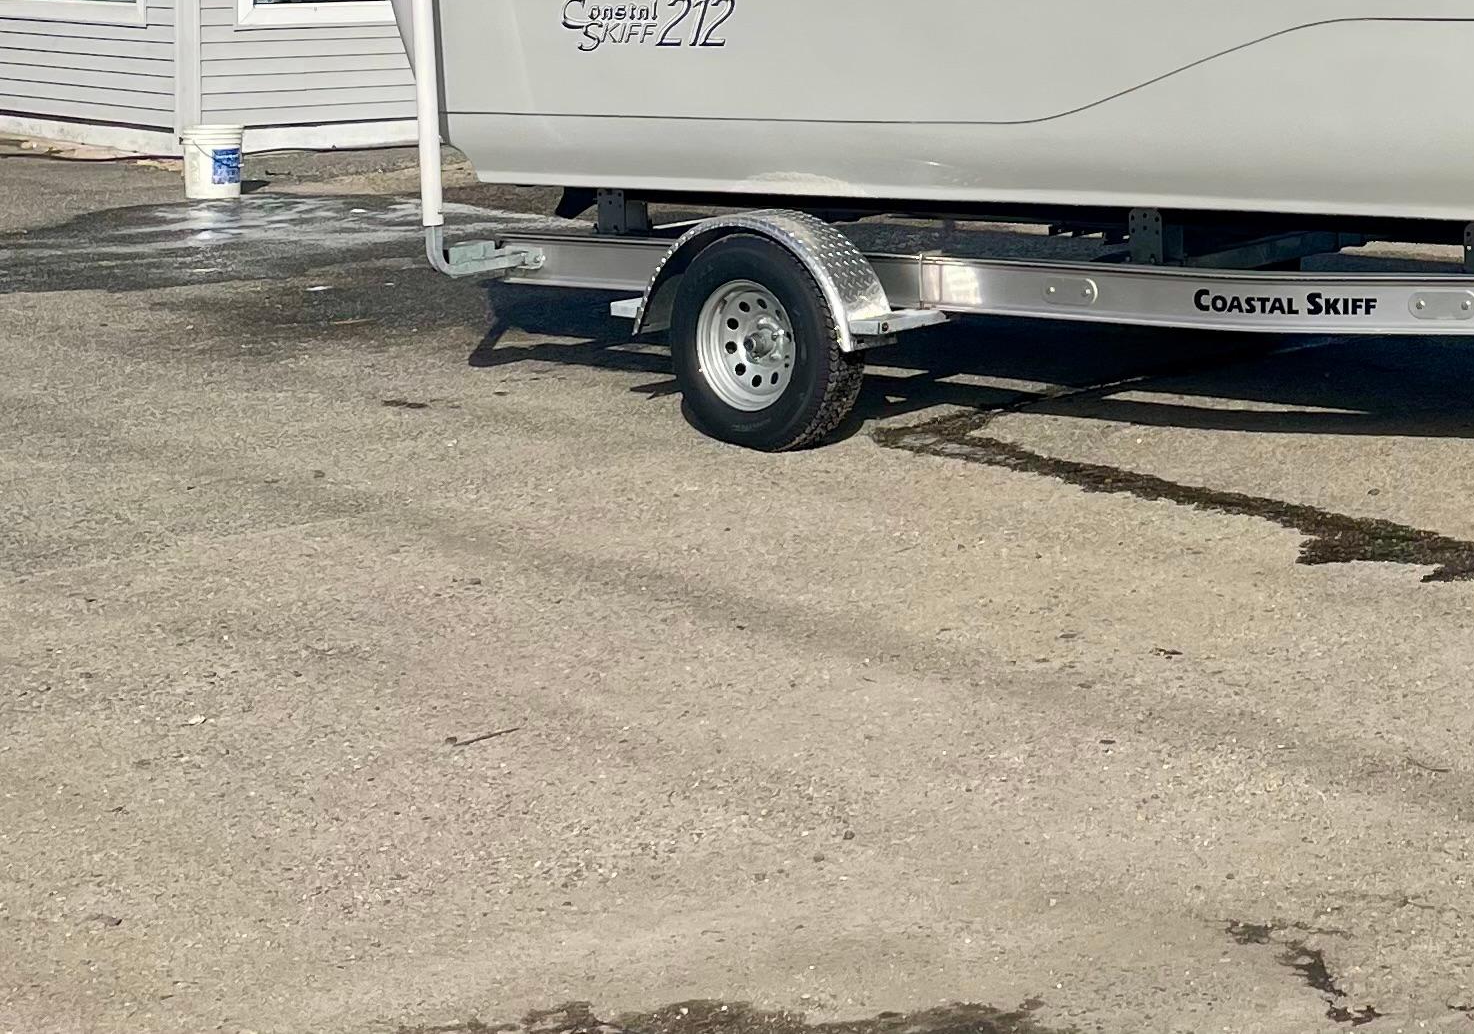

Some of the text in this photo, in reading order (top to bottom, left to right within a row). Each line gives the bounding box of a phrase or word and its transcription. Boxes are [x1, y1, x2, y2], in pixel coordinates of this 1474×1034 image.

[577, 21, 658, 52] SKIFF
[1194, 288, 1377, 316] COASTAL SKIFF
